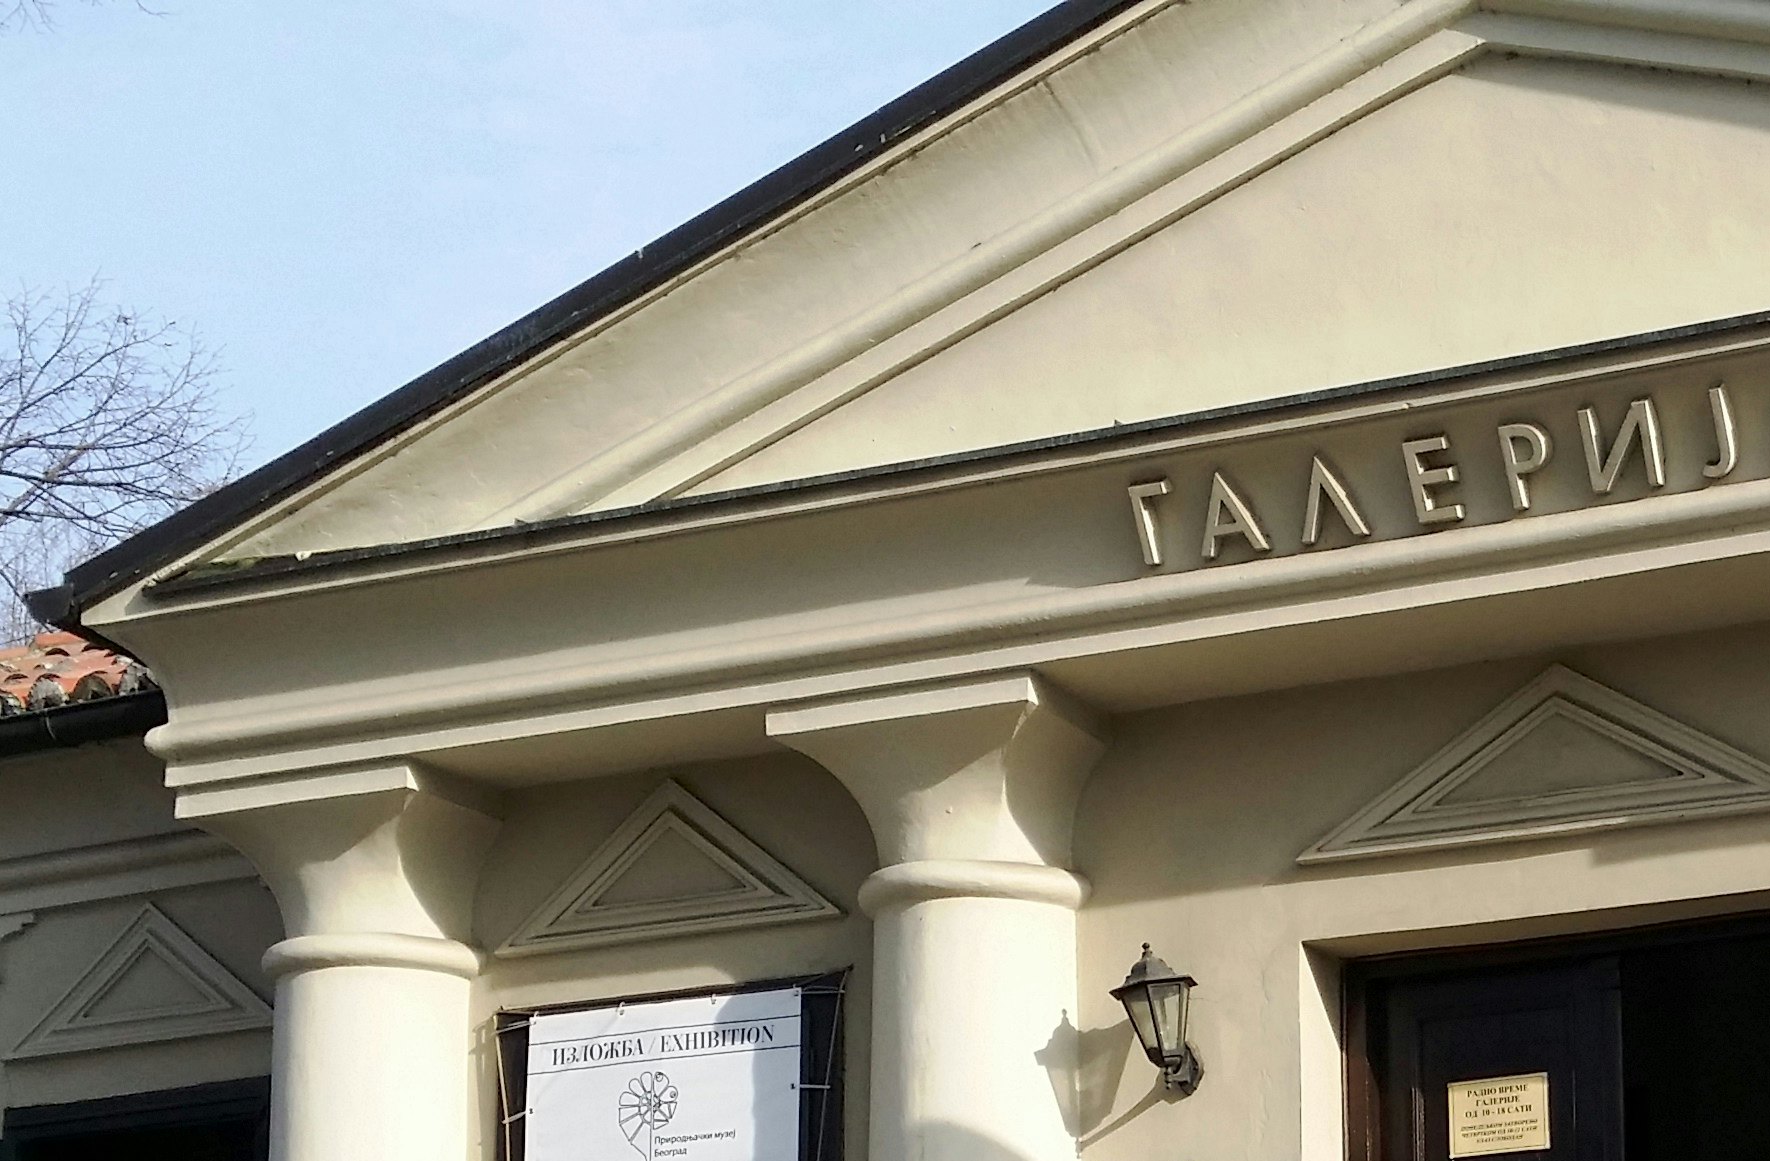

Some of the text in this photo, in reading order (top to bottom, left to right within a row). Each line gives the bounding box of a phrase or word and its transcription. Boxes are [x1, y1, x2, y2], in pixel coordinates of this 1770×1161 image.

[552, 1038, 644, 1066] ИЗЛОЖБА
[660, 1024, 775, 1053] EXHIBITION
[1498, 1084, 1528, 1094] ВРЕМЕ
[1465, 1111, 1478, 1119] ОД
[1507, 1105, 1532, 1114] САТИ
[654, 1148, 687, 1157] Београд
